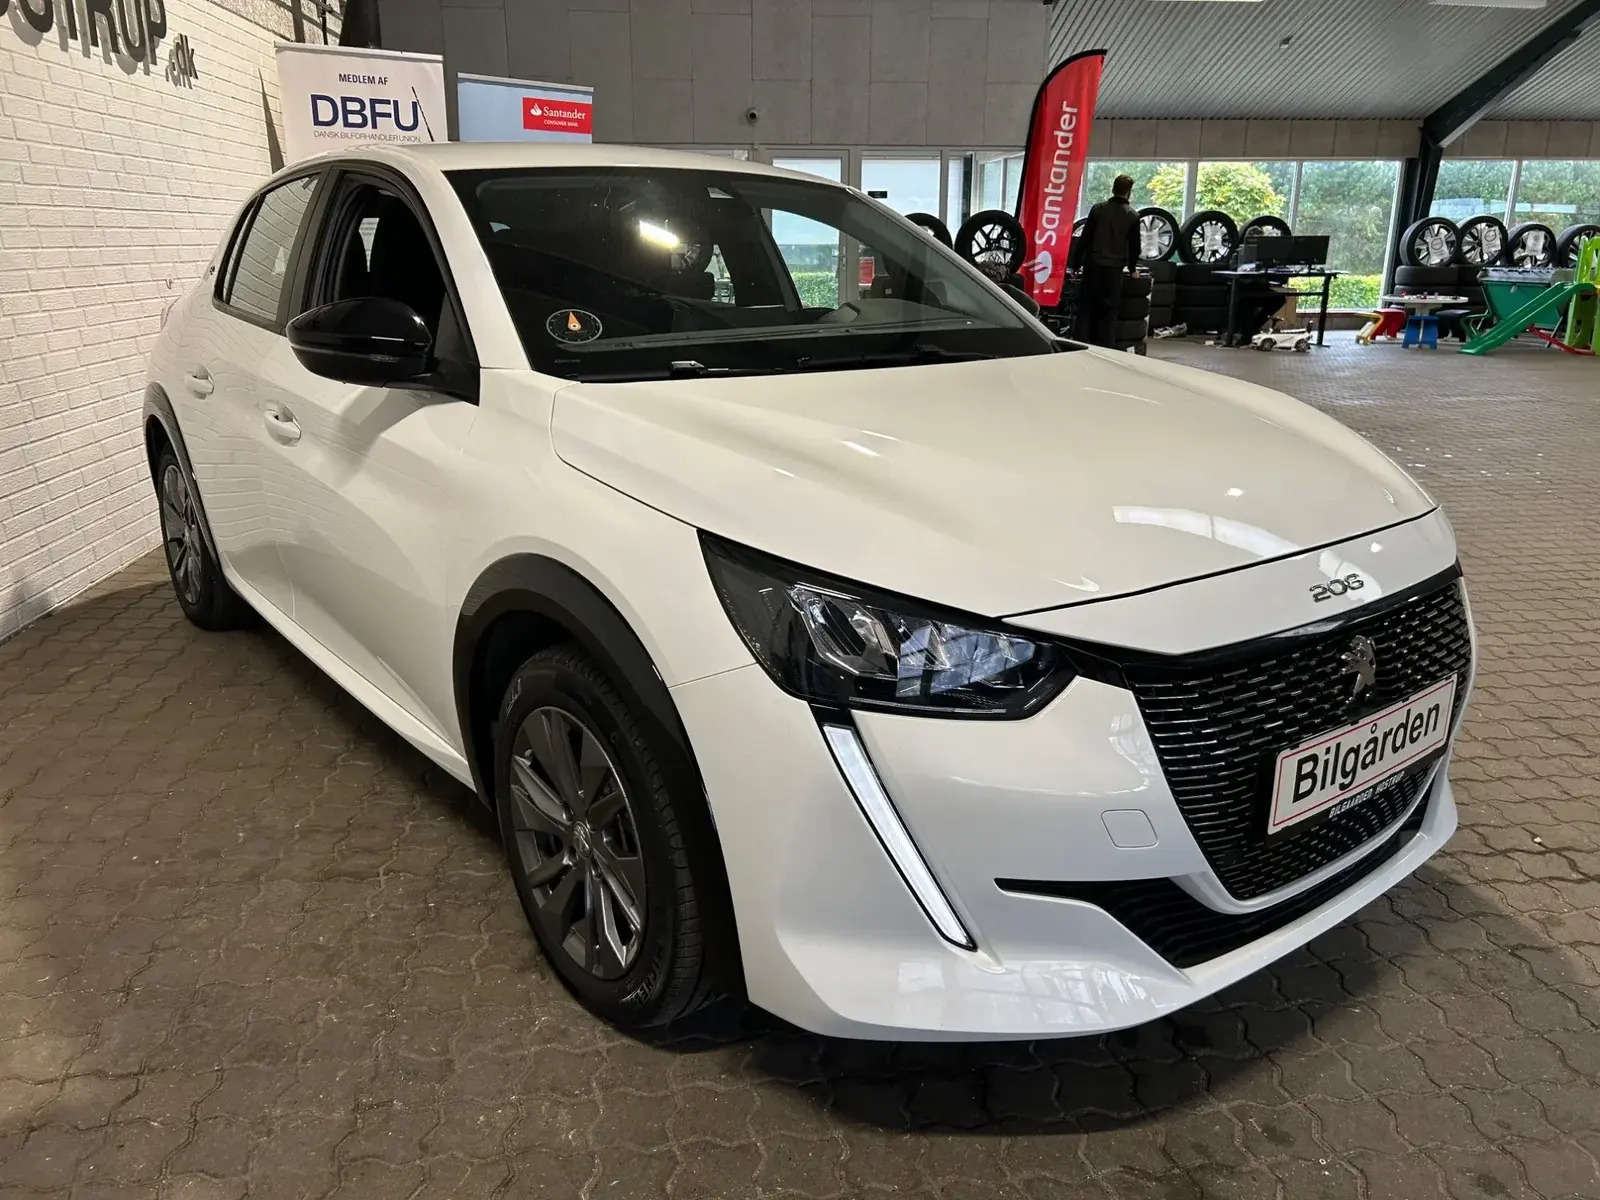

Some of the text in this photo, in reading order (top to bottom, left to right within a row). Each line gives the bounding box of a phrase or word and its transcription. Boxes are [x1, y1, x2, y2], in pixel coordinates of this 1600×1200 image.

[338, 73, 389, 86] MEDLEM AF
[310, 93, 419, 132] DBFU
[543, 105, 587, 120] Santander
[313, 130, 421, 143] DANSK BILFORHANDLER UNION
[1034, 101, 1078, 247] Santander
[1292, 703, 1440, 803] Bilgården
